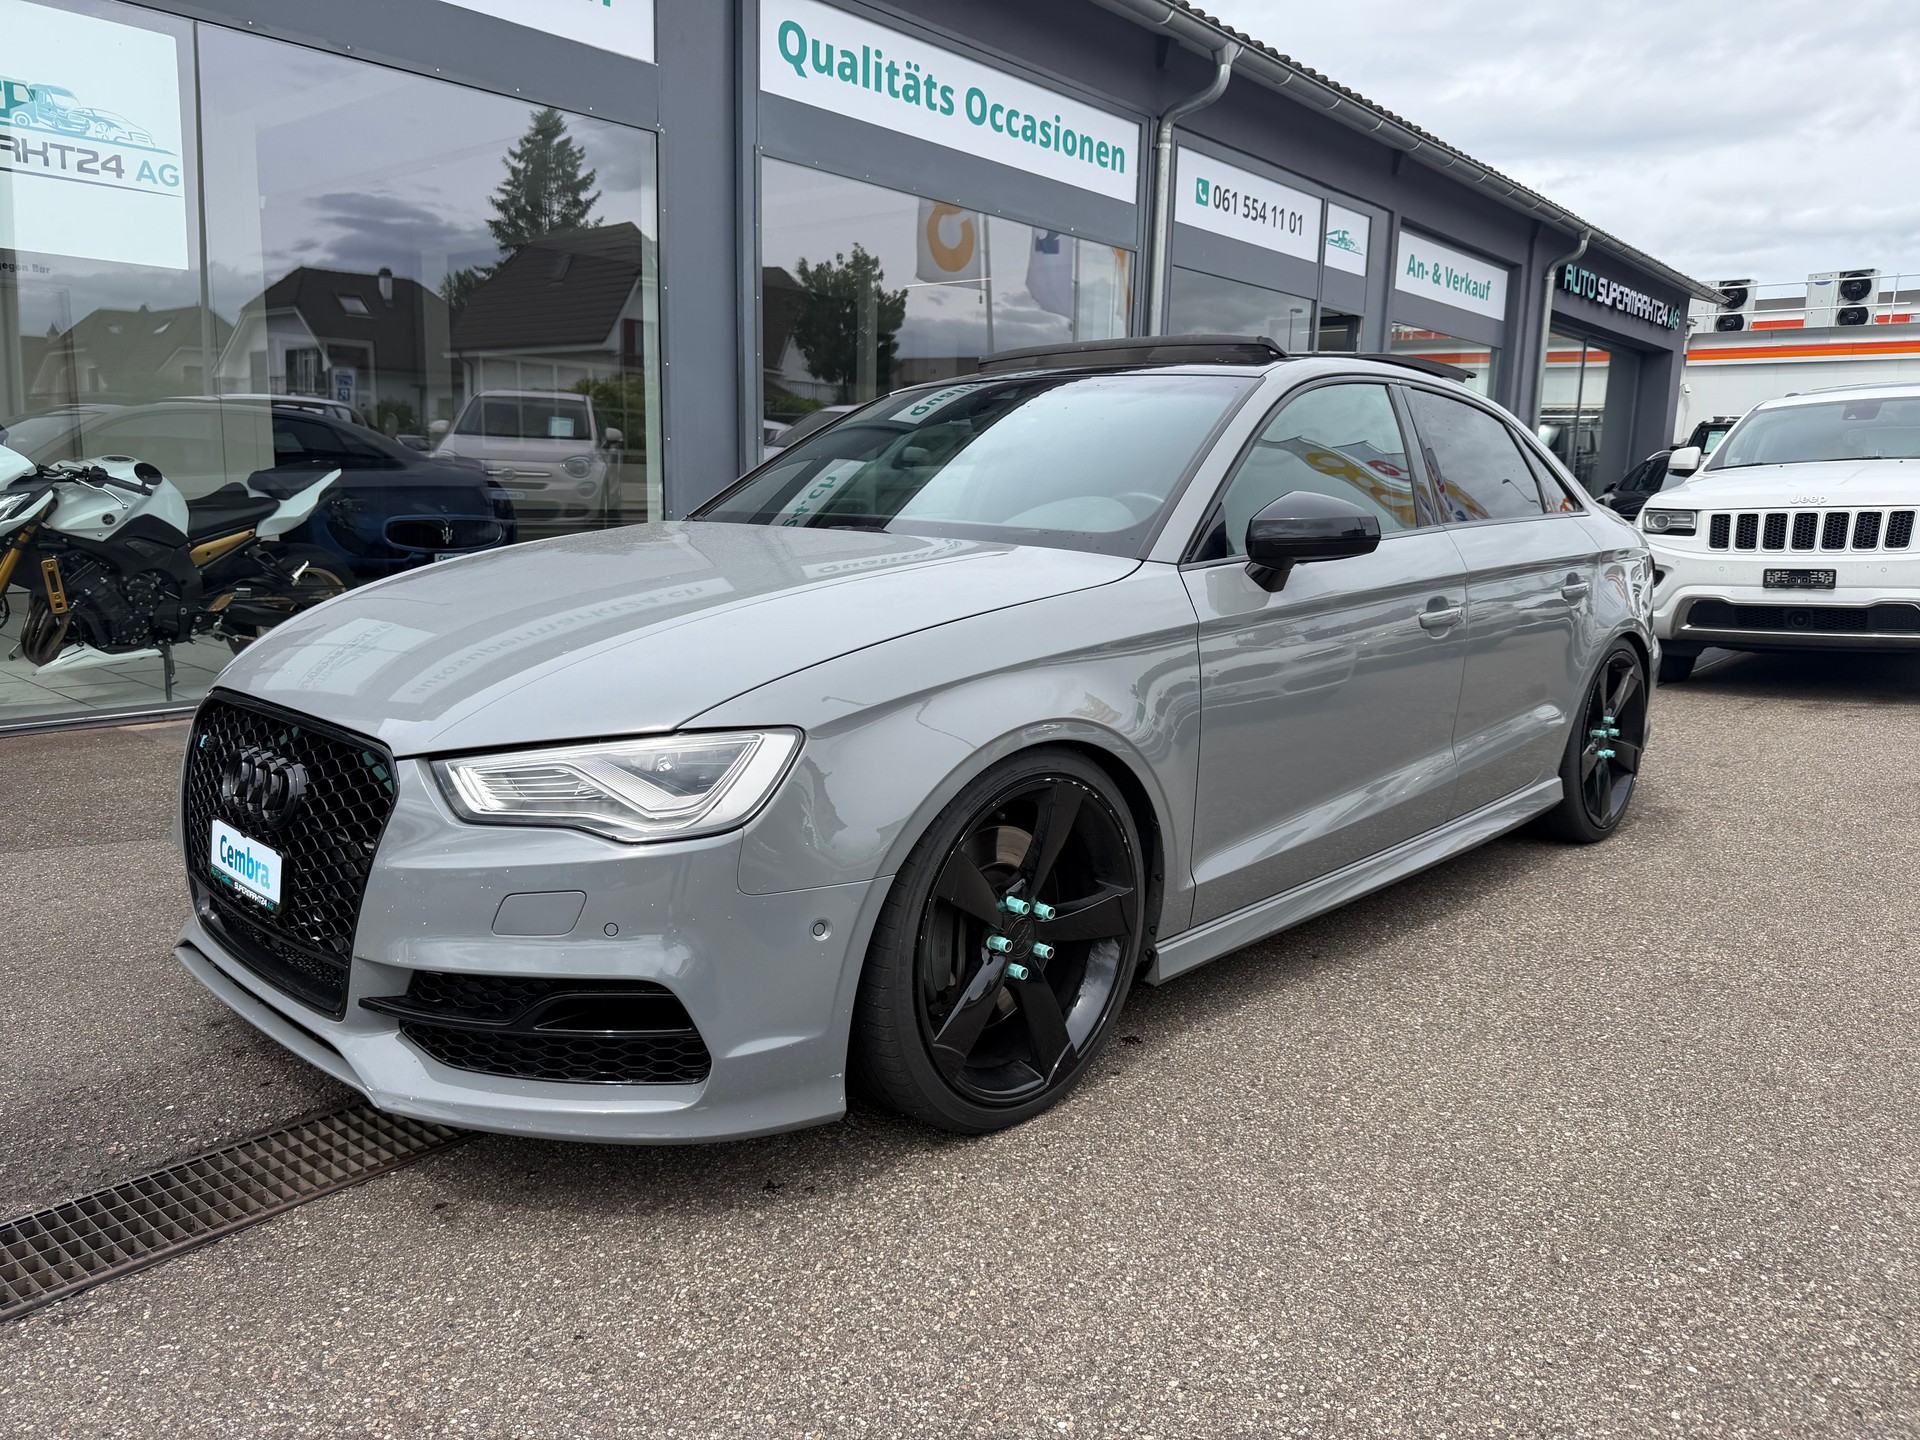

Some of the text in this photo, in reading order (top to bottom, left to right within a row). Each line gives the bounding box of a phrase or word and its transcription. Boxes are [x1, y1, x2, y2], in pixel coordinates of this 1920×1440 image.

[777, 20, 1126, 173] Qualitäts Occasionen
[135, 160, 180, 187] AG
[1213, 185, 1303, 236] 061 554 11 01
[1406, 253, 1491, 301] An- & Verkauf
[1563, 263, 1680, 331] AUTO SUPERMARKT24 AG
[1789, 494, 1828, 505] Jeep
[220, 834, 271, 889] Cembra
